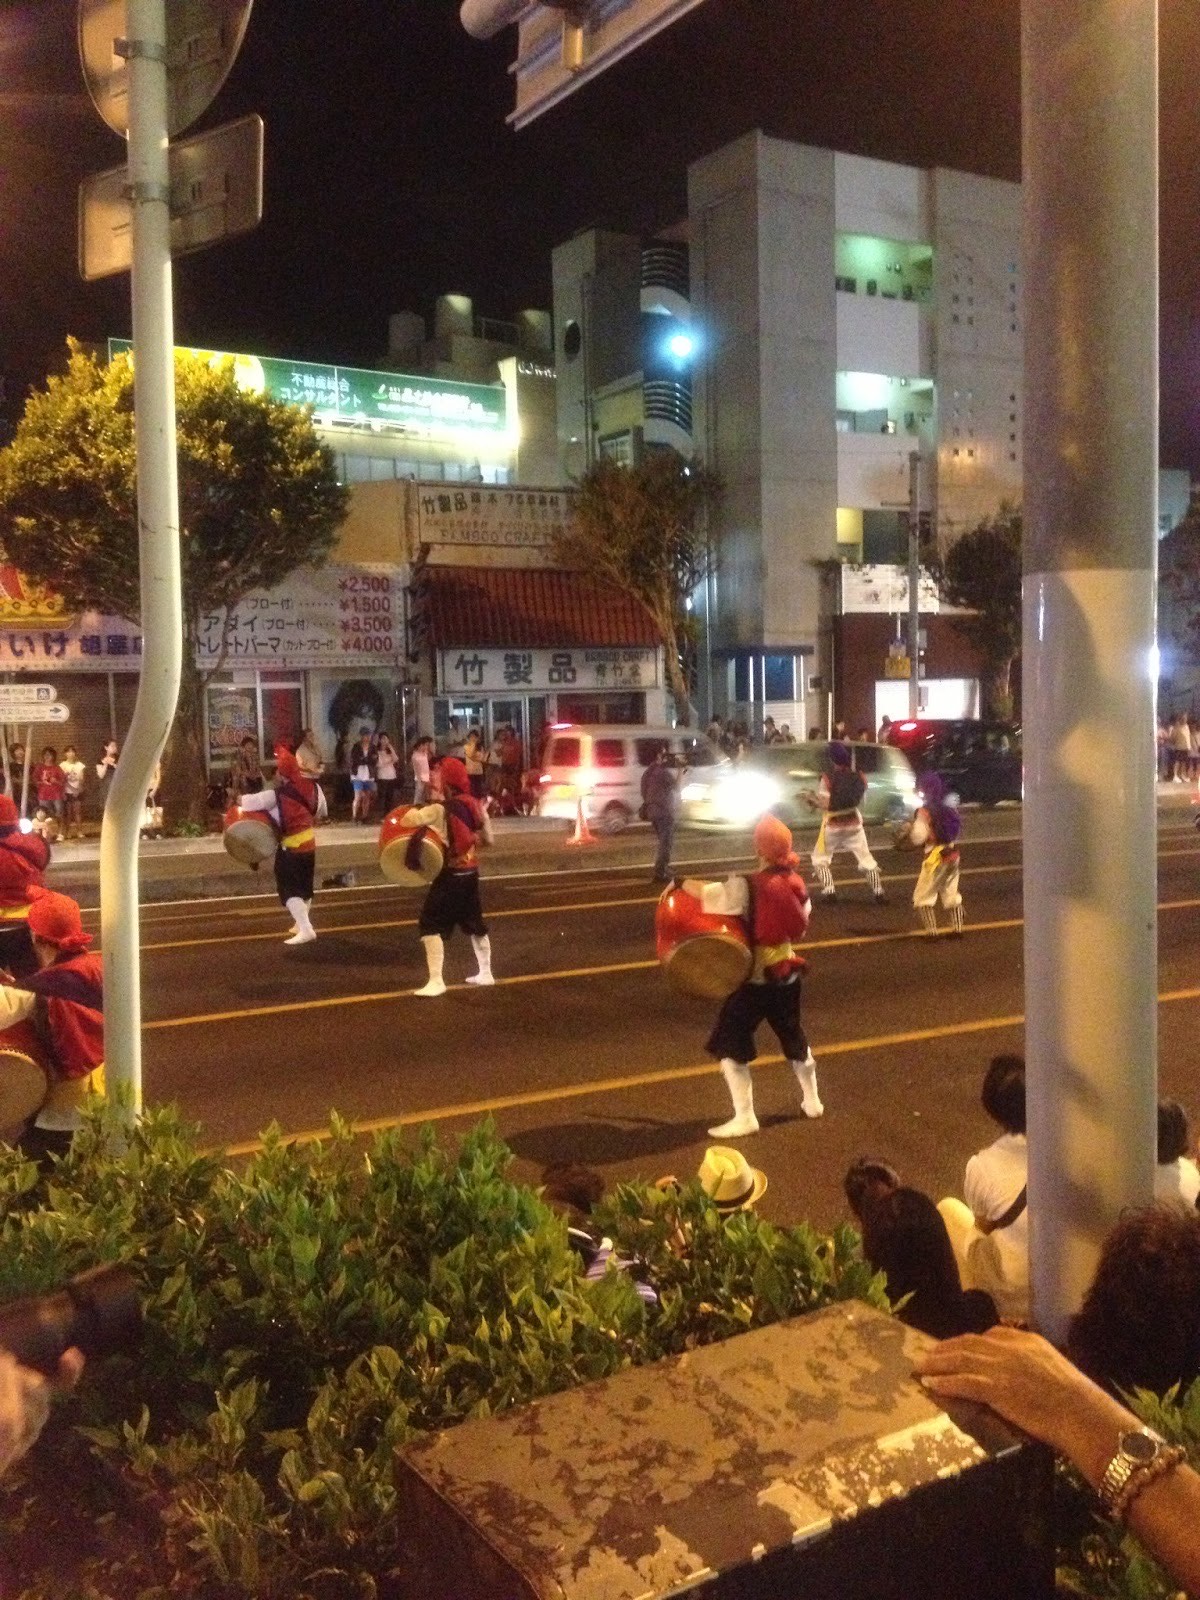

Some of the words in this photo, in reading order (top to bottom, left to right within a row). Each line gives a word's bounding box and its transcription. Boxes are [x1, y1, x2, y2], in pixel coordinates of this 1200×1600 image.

[280, 387, 361, 407] コンサルタント
[454, 652, 577, 686] 竹製品
